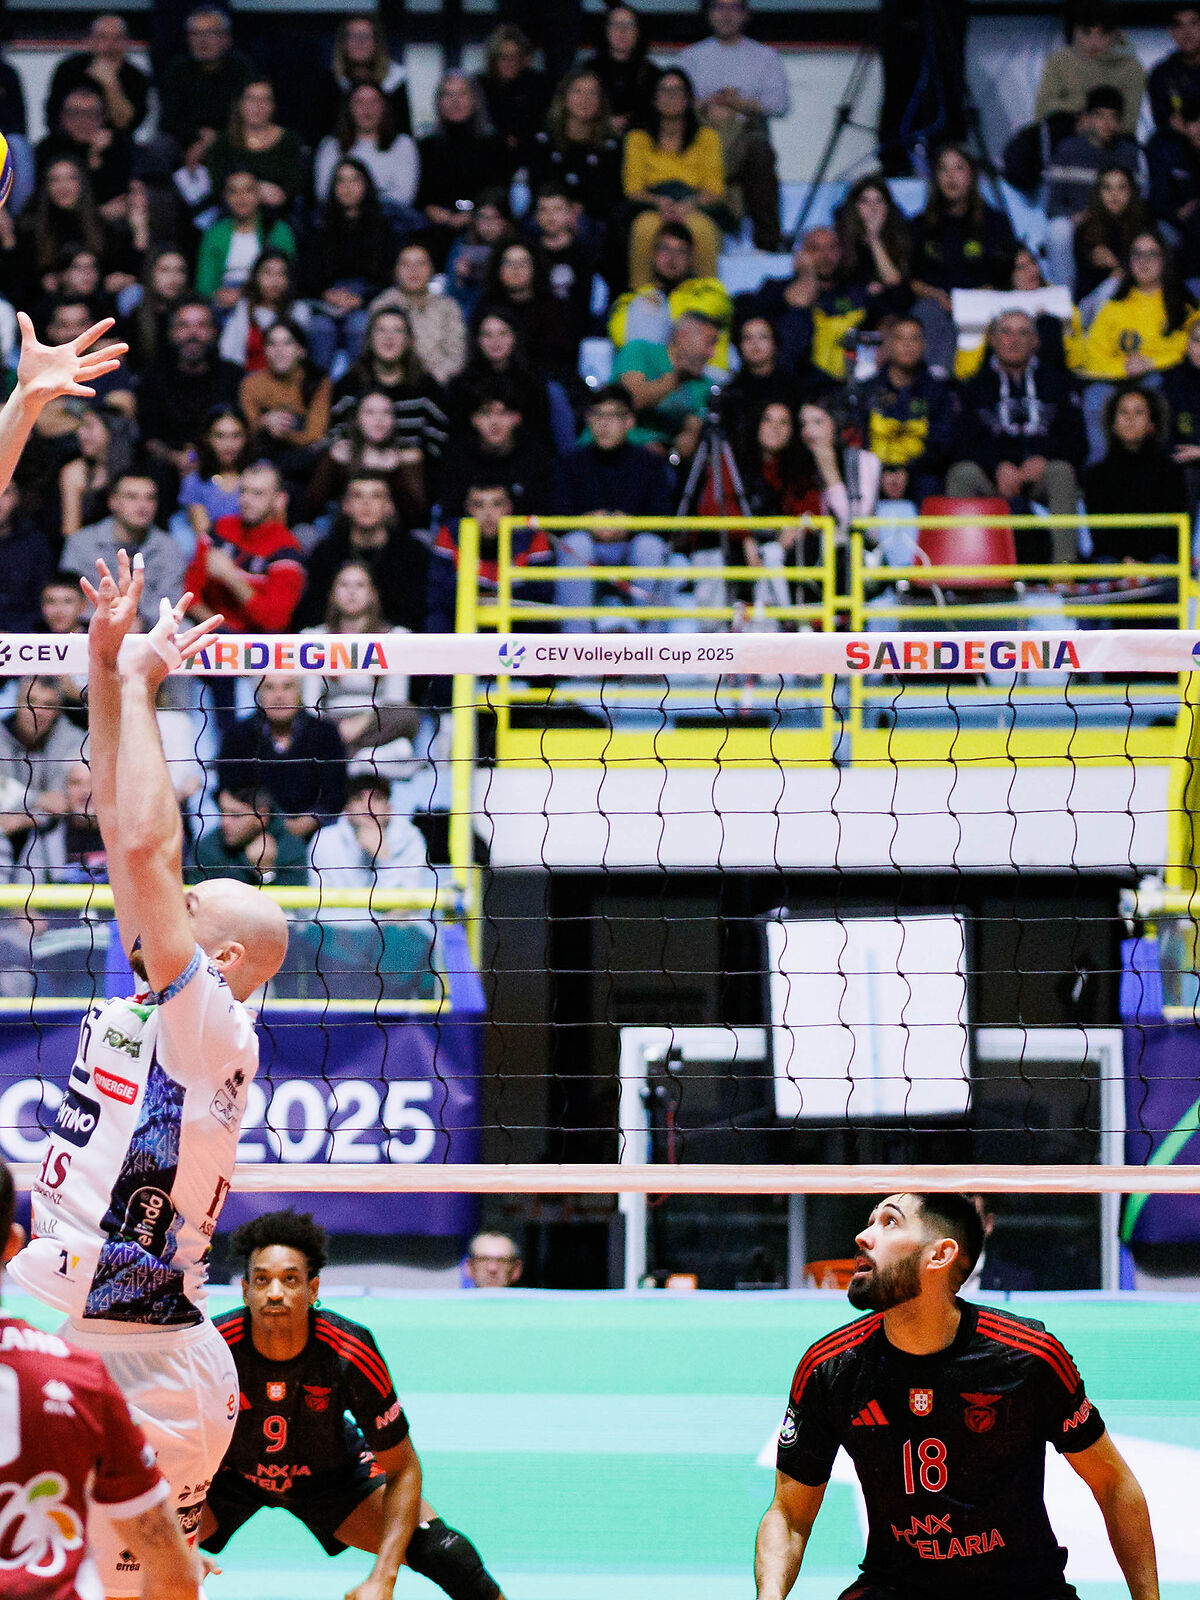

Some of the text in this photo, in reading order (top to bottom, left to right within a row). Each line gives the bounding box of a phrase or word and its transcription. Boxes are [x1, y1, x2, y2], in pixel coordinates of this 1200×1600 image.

[18, 645, 69, 661] CEV
[185, 642, 388, 670] ARDEGNA
[536, 647, 734, 664] CEV Volleyball Cup 2025
[846, 641, 1080, 669] SARDEGNA
[55, 1102, 96, 1133] NTINO
[238, 1079, 438, 1164] 2025
[263, 1415, 287, 1453] 9
[257, 1463, 290, 1478] NX
[903, 1437, 948, 1495] 18
[911, 1513, 952, 1535] NX
